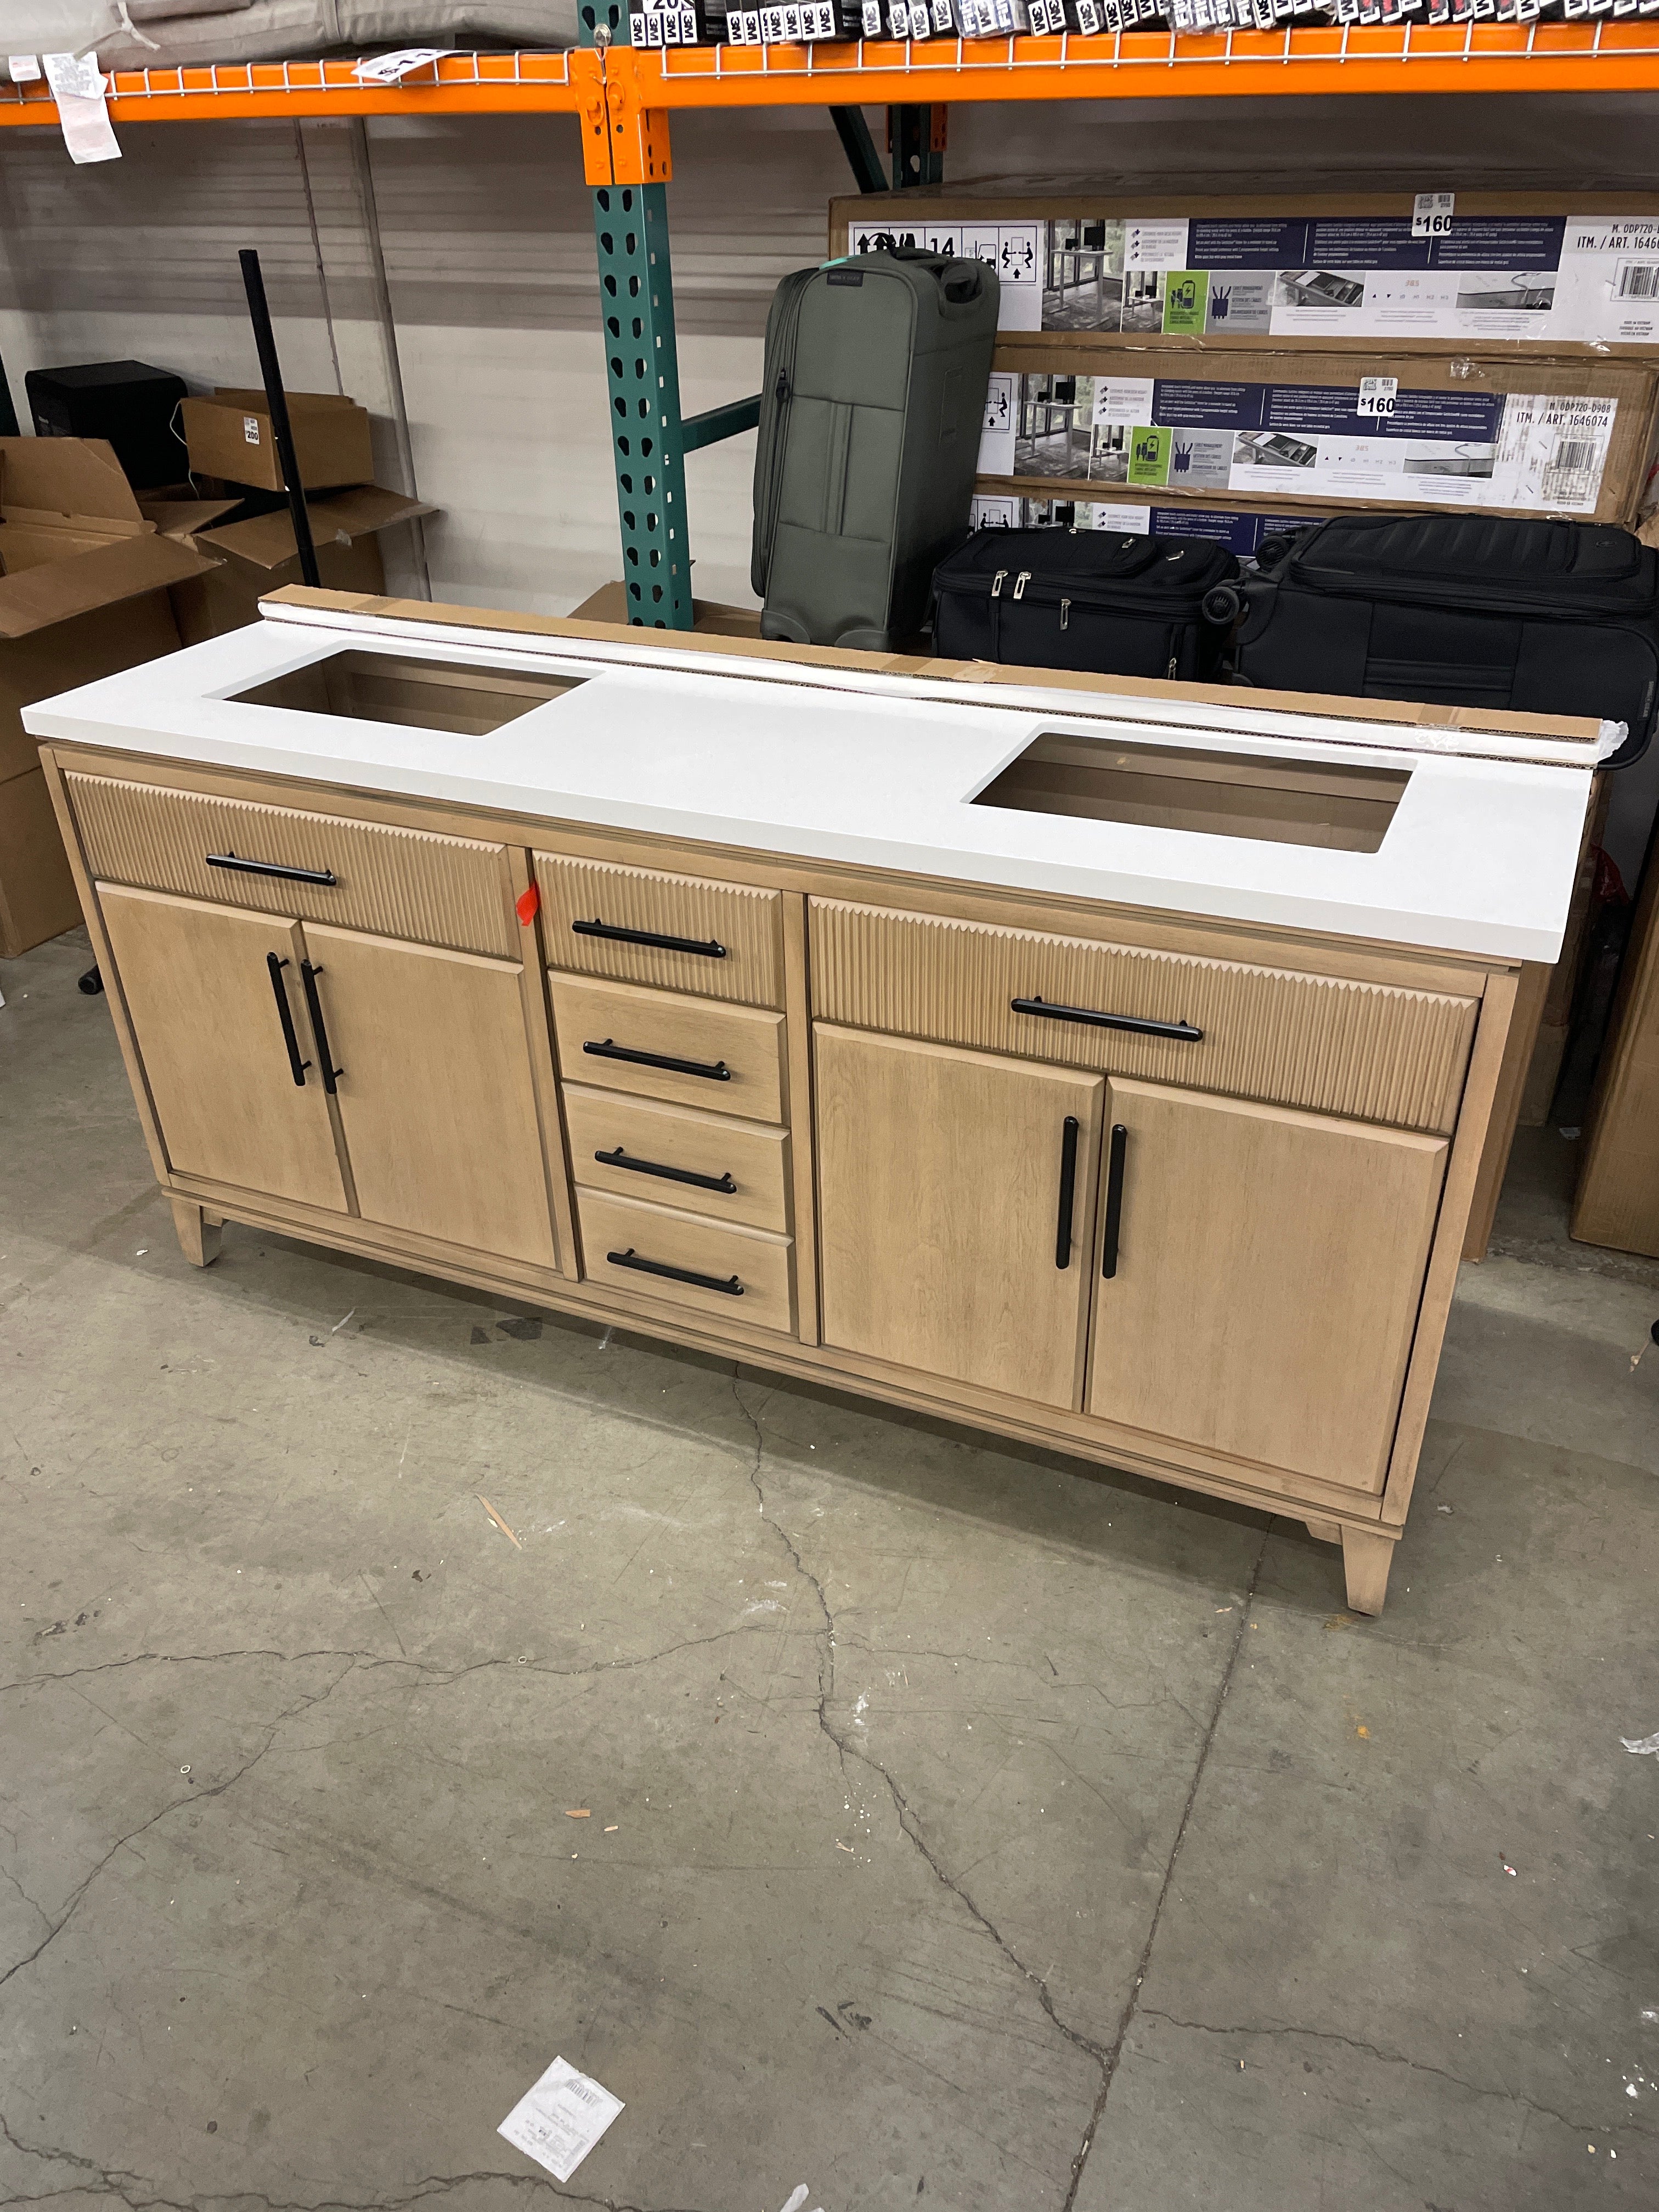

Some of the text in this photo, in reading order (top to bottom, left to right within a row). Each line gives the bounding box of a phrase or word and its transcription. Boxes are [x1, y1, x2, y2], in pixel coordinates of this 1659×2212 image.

[770, 12, 782, 36] 3M
[786, 10, 798, 35] 3M
[803, 9, 815, 34] 3M
[820, 7, 831, 32] 3M
[865, 7, 878, 31] 3M
[893, 9, 905, 33] 3M
[913, 10, 926, 35] 3M
[936, 1, 949, 26] 3M
[1032, 6, 1045, 31] 3M
[1049, 0, 1062, 25] 3M
[1080, 3, 1095, 29] 3M
[1107, 2, 1119, 28] 3M
[633, 18, 643, 41] 3M
[650, 18, 658, 41] 3M
[667, 15, 676, 38] 3M
[684, 15, 693, 38] 3M
[731, 16, 742, 40] 3M
[746, 16, 757, 40] 3M
[1416, 215, 1452, 232] $160
[1624, 224, 1659, 234] ODP720-
[930, 237, 955, 256] 14
[1577, 236, 1597, 249] ITM.
[1600, 235, 1607, 250] /
[1609, 236, 1629, 249] ART.
[1361, 397, 1396, 413] $160
[1517, 412, 1609, 427] ITM. / ART. 1646074
